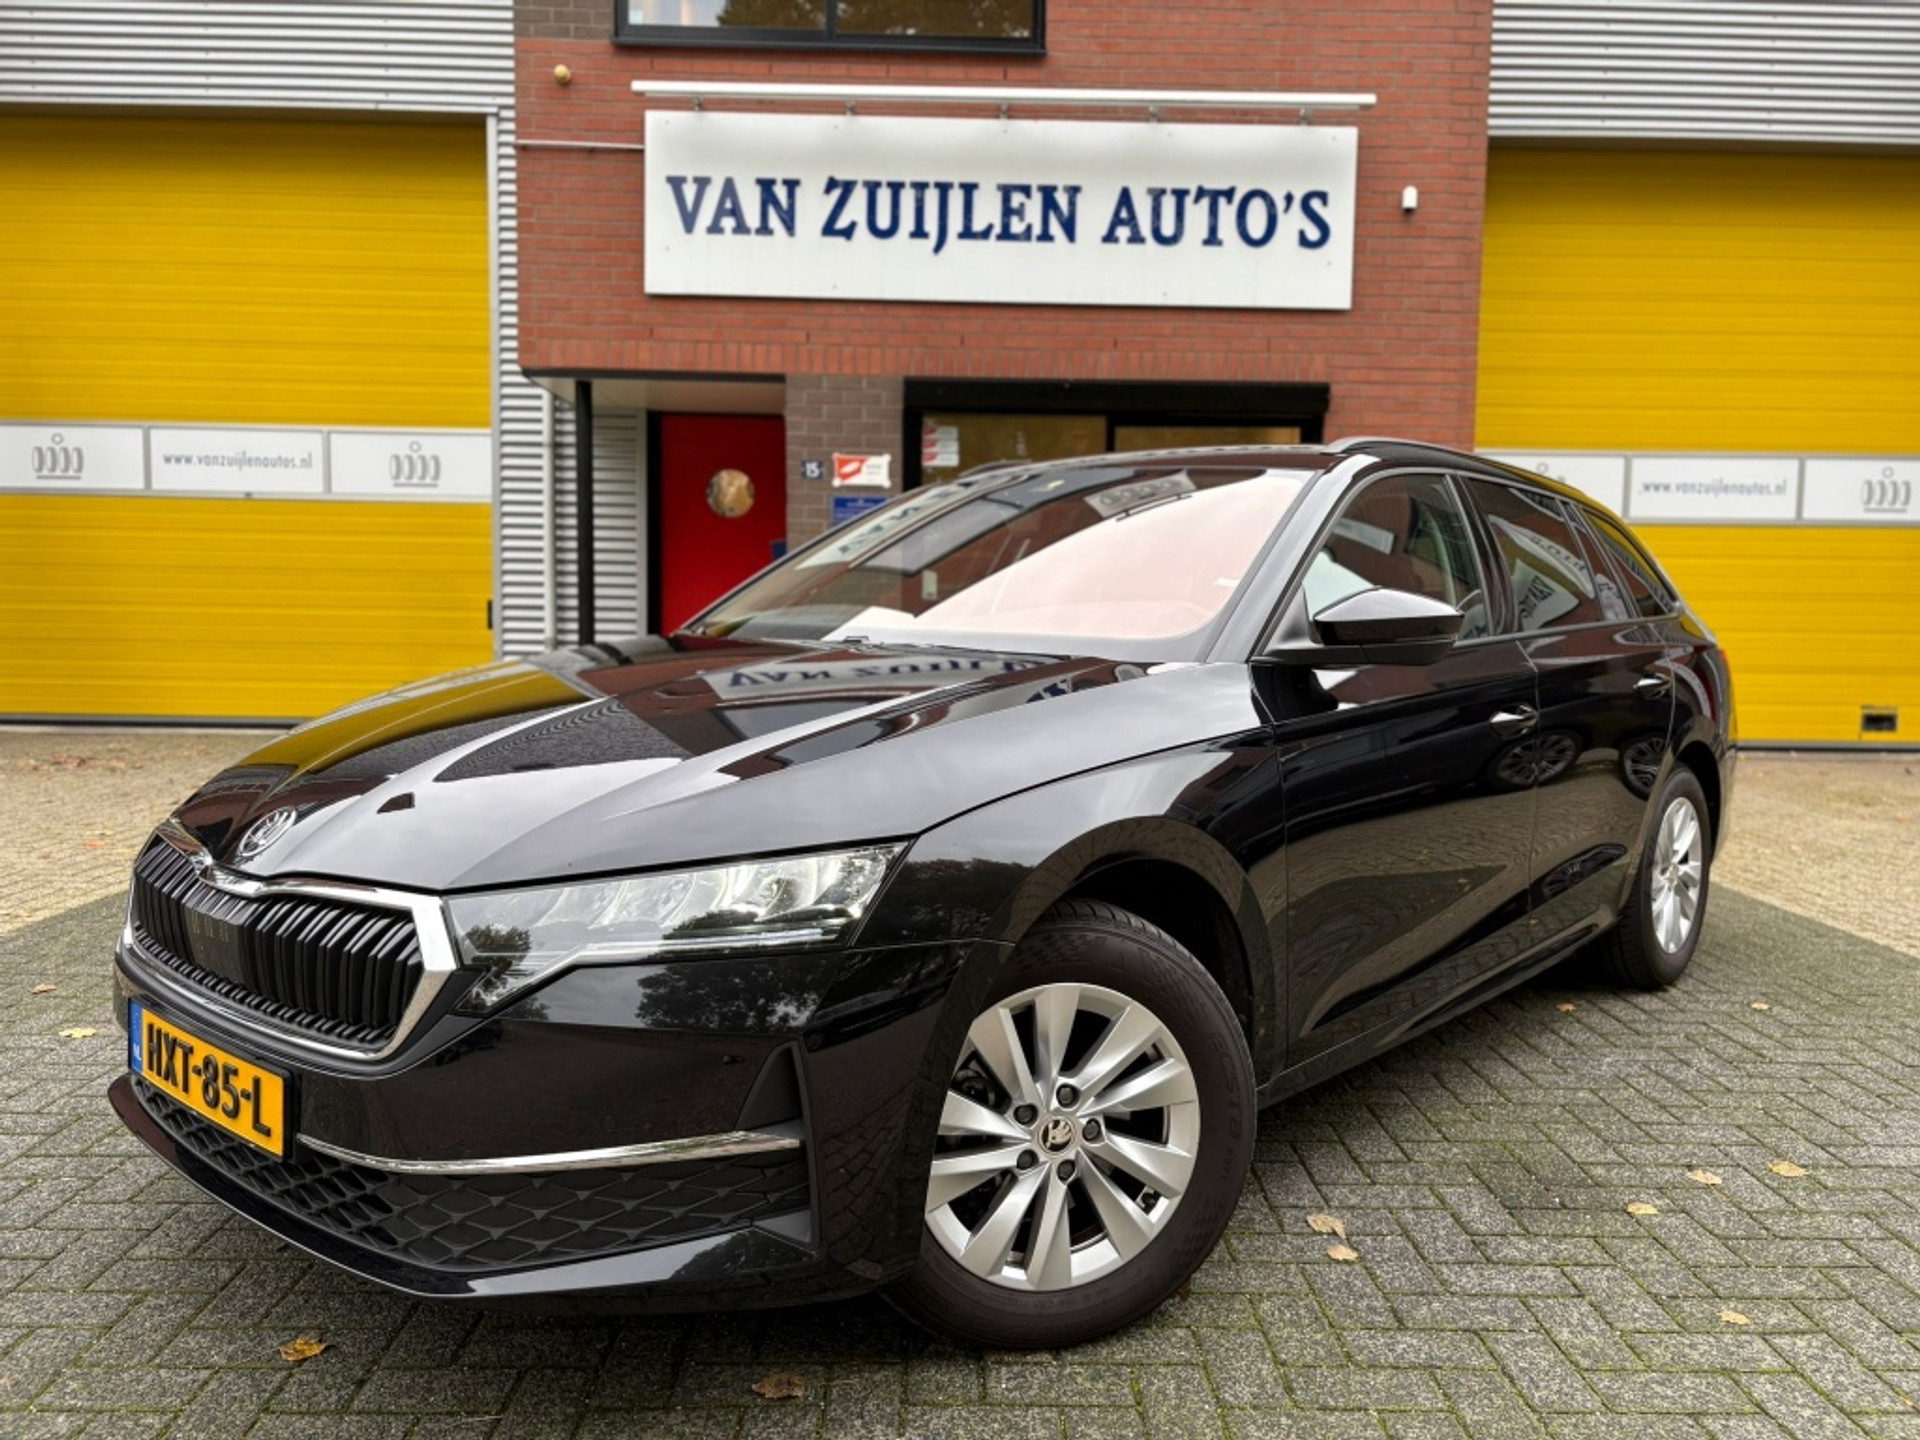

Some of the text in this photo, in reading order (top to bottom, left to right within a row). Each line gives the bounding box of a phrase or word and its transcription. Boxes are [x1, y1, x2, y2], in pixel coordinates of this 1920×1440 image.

[666, 176, 1331, 255] VAN ZUIJLEN AUTO'S
[162, 450, 313, 471] www.vanzuijlenautos.nl
[147, 1022, 271, 1137] HXT-85-L
